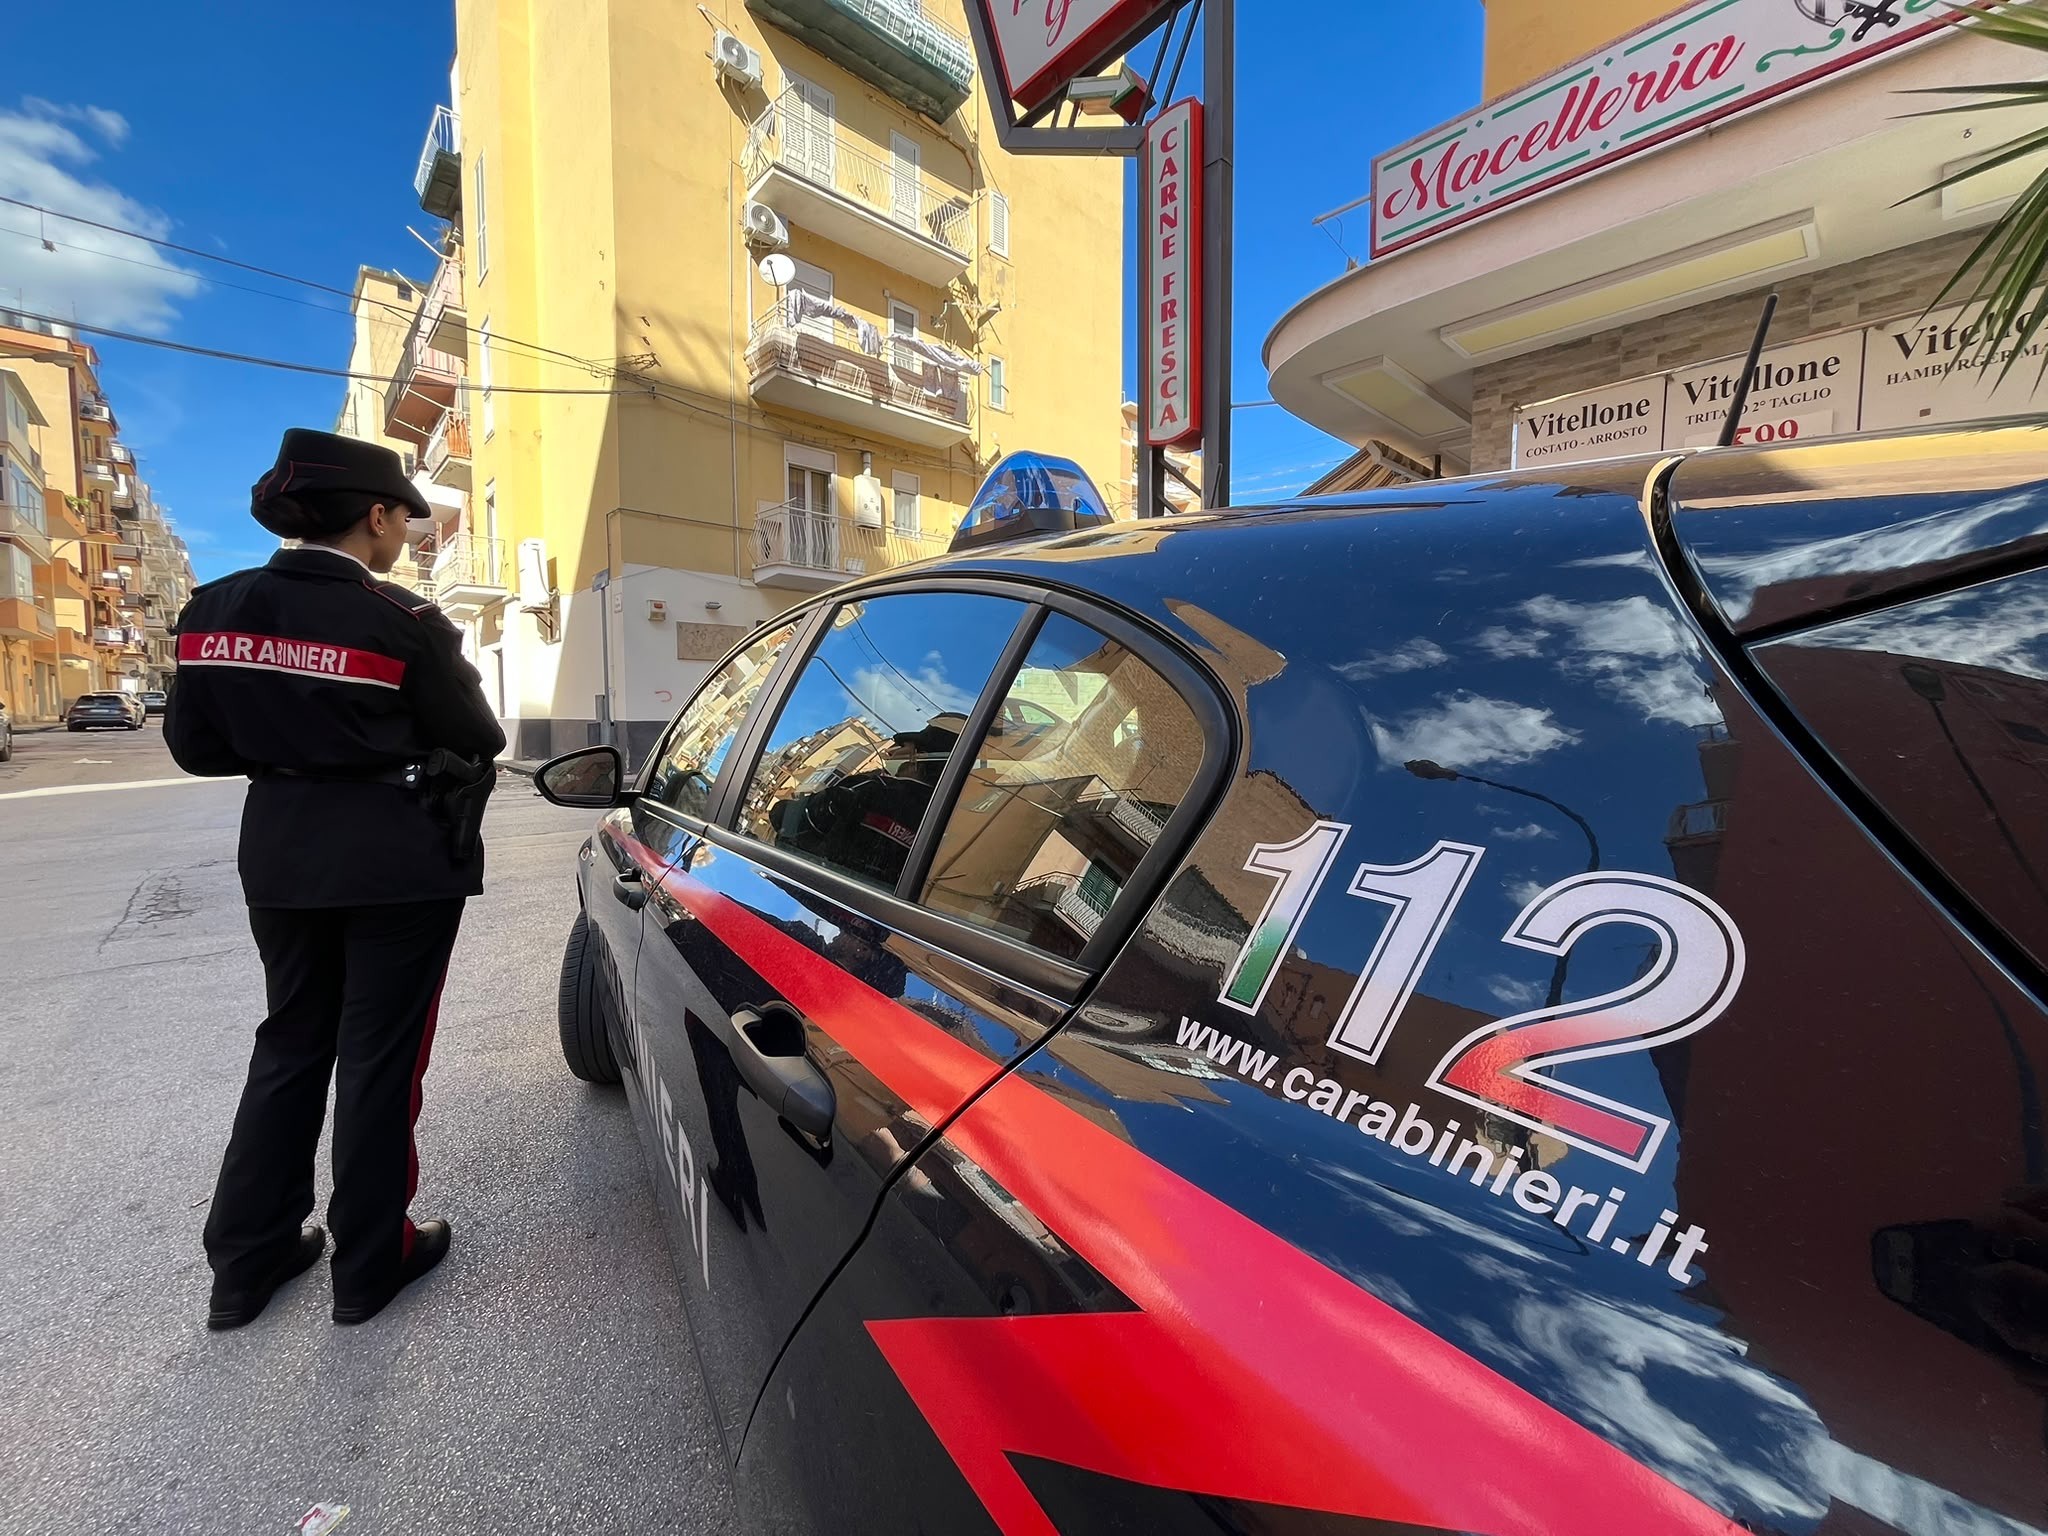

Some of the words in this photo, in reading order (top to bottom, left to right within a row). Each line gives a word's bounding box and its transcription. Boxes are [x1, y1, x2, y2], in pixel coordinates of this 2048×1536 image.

[1383, 34, 1746, 221] Macelleria
[1158, 126, 1179, 260] CARNE
[1158, 272, 1179, 427] FRESCA
[1683, 355, 1841, 406] Vitllone
[1526, 439, 1578, 458] COSTATO
[1587, 425, 1648, 447] ARROSTO
[1528, 398, 1651, 440] Vitellone
[1685, 404, 1748, 426] TRITA
[1769, 387, 1832, 409] TAGLIO
[201, 635, 348, 673] CARABINIERI
[1217, 820, 1746, 1174] 112
[1175, 1014, 1709, 1285] www.carabinieri.it
